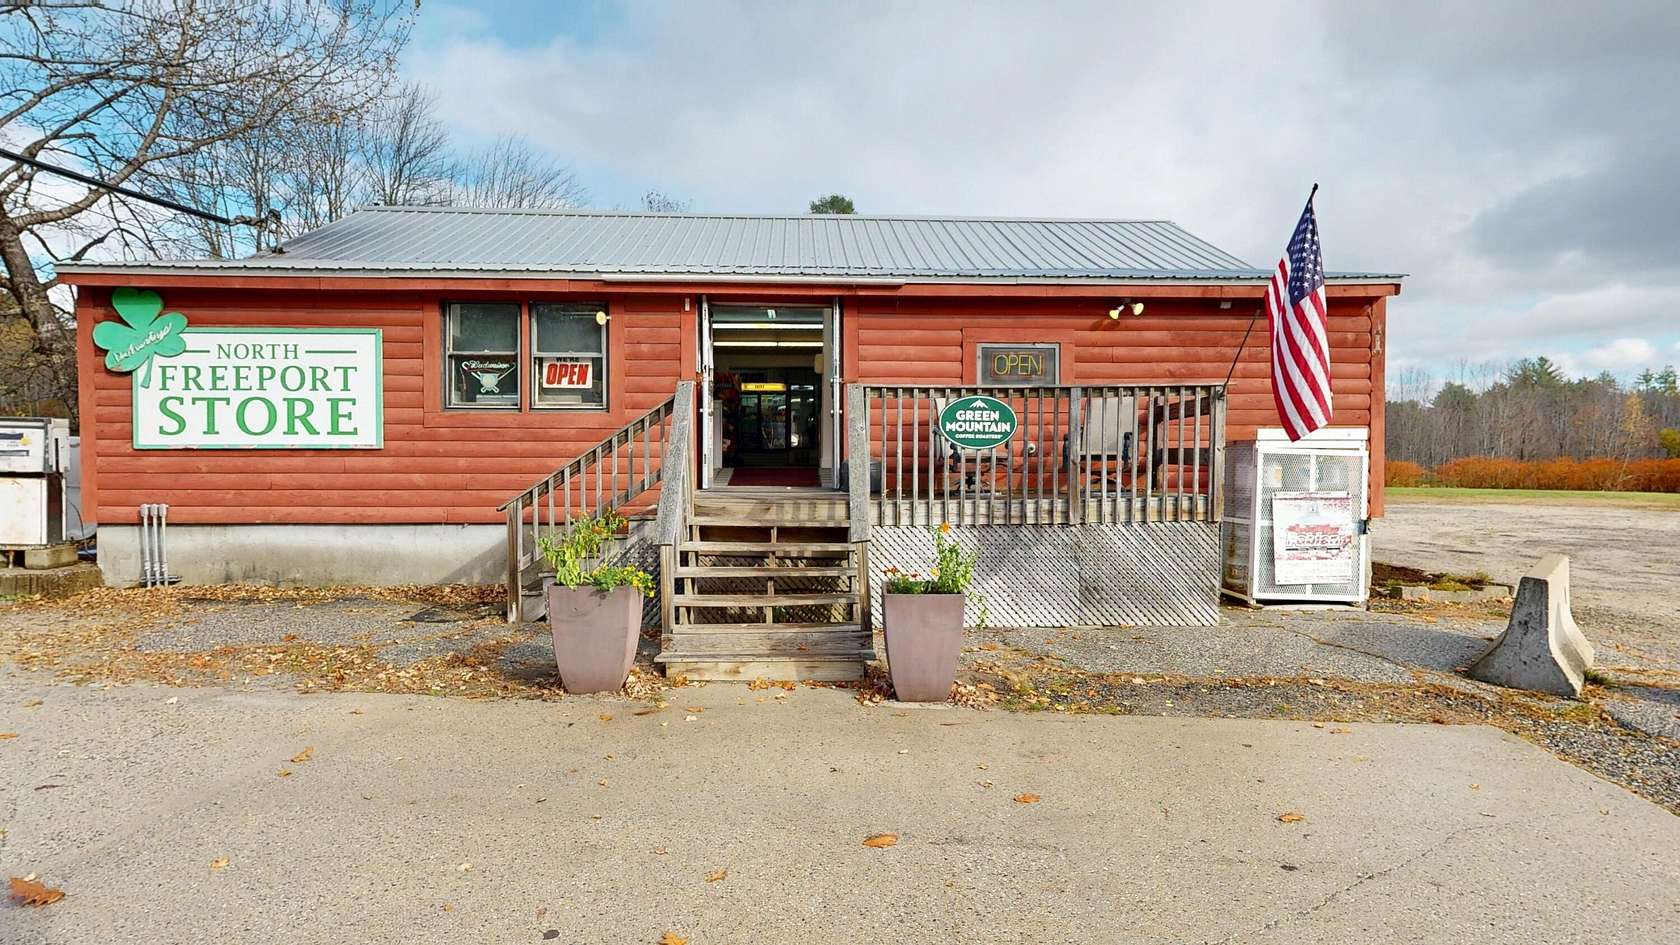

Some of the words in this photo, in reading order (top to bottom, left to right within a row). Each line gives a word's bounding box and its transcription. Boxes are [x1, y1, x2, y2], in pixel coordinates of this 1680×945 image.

[217, 343, 299, 360] NORTH
[470, 360, 510, 369] Budweiser
[994, 354, 1042, 375] OPEN
[158, 365, 358, 392] FREEPORT
[546, 364, 590, 385] OPEN
[158, 396, 358, 436] STORE
[955, 410, 1000, 421] GREEN
[945, 421, 1011, 433] MOUNTAIN
